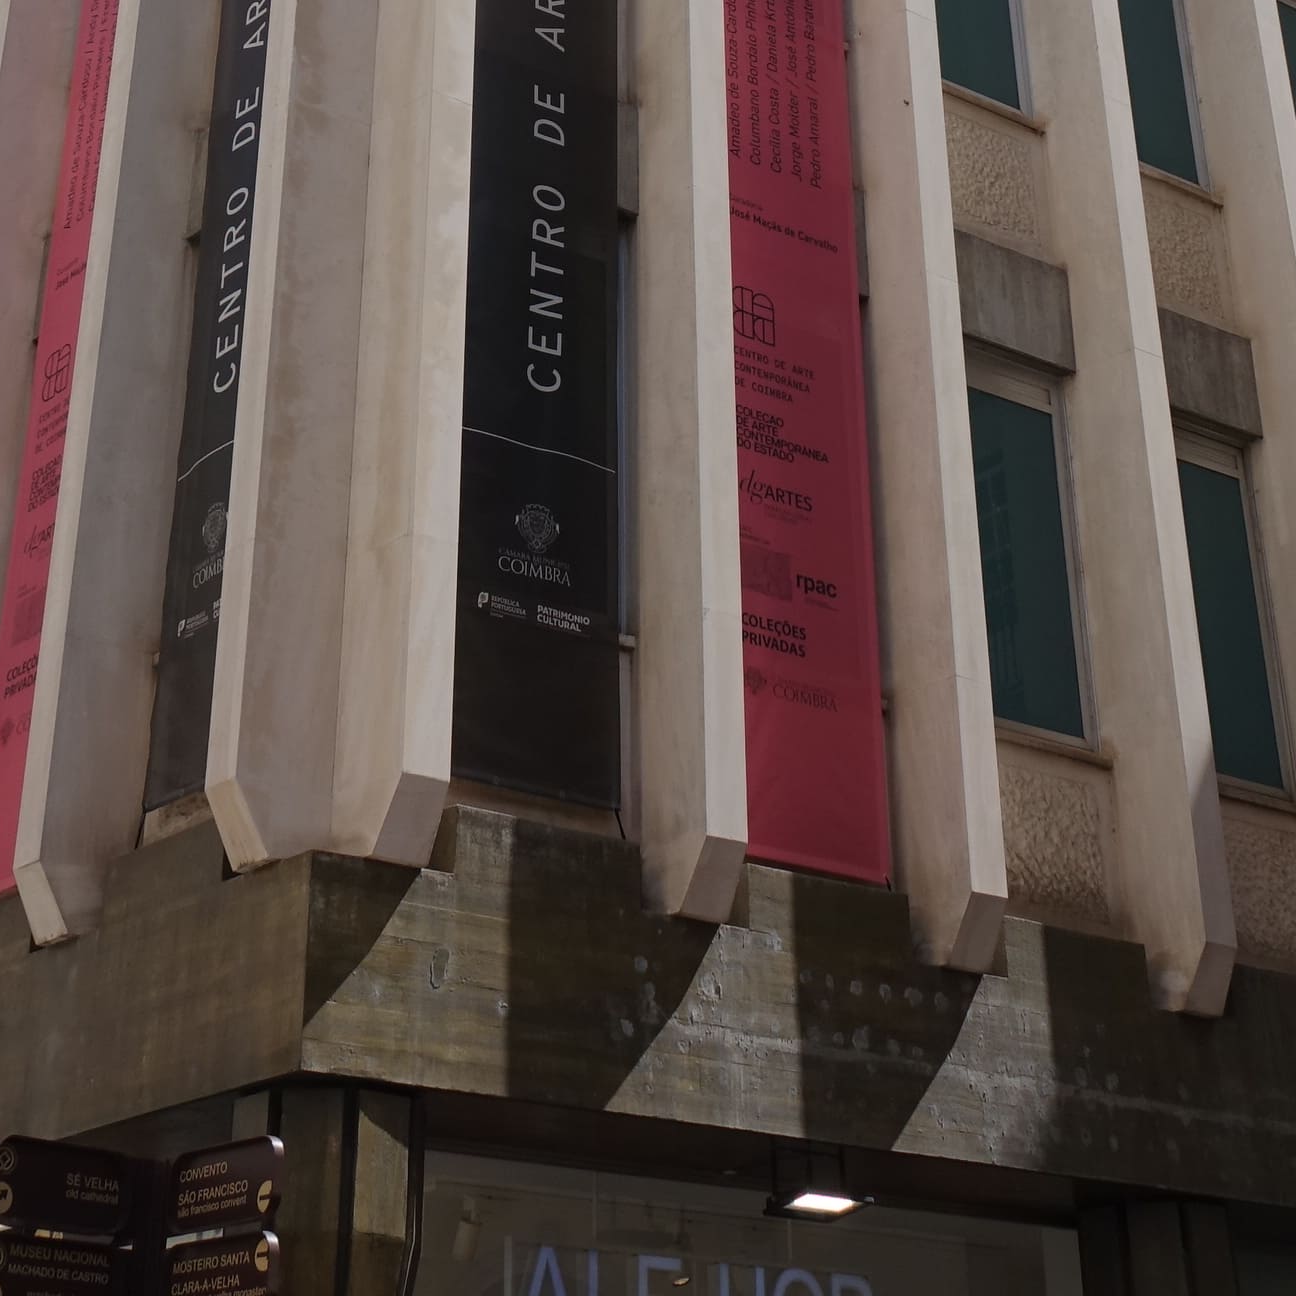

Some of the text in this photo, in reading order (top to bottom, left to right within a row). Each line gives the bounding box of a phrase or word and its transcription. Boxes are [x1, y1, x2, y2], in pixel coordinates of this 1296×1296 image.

[746, 35, 759, 85] Bordalo
[765, 25, 778, 72] Daniela
[785, 46, 797, 78] José
[805, 44, 817, 82] Pedro
[727, 83, 739, 98] de
[230, 85, 261, 153] DE
[533, 84, 566, 147] DE
[768, 88, 780, 125] Costa
[807, 97, 820, 145] Amaral
[727, 103, 742, 158] Amadeo
[749, 89, 761, 166] Columbano
[789, 142, 803, 182] Jorge
[808, 149, 822, 190] Pedro
[730, 206, 750, 221] José
[784, 226, 795, 238] de
[798, 230, 838, 254] Carvalho
[211, 187, 251, 394] CENTRO
[527, 184, 565, 394] CENTRO
[734, 346, 816, 380] CENTRO DE ARTE
[735, 361, 810, 393] CONTEMPORÂNEA
[735, 376, 793, 402] DE COIMBRA
[737, 415, 779, 437] DE ARTE
[737, 436, 795, 463] DO ESTADO
[193, 557, 224, 589] COIMB
[498, 556, 571, 587] COIMBRA
[796, 574, 837, 598] rpac
[537, 614, 582, 632] CULTURAL
[742, 612, 807, 640] COLEÇÕES
[742, 630, 806, 658] PRIVADAS
[772, 683, 838, 713] COIMBRA
[66, 1172, 119, 1192] SÉ VELHA
[180, 1160, 228, 1183] CONVENTO
[178, 1179, 248, 1206] SÃO FRANCISCO
[221, 1194, 247, 1210] convent
[10, 1243, 110, 1267] MUSEU NACIONAL
[173, 1250, 251, 1274] MOSTEIRO SANTA
[8, 1263, 109, 1285] MACHADO DE CASTRO
[171, 1274, 240, 1296] CLARA-A-VELHA
